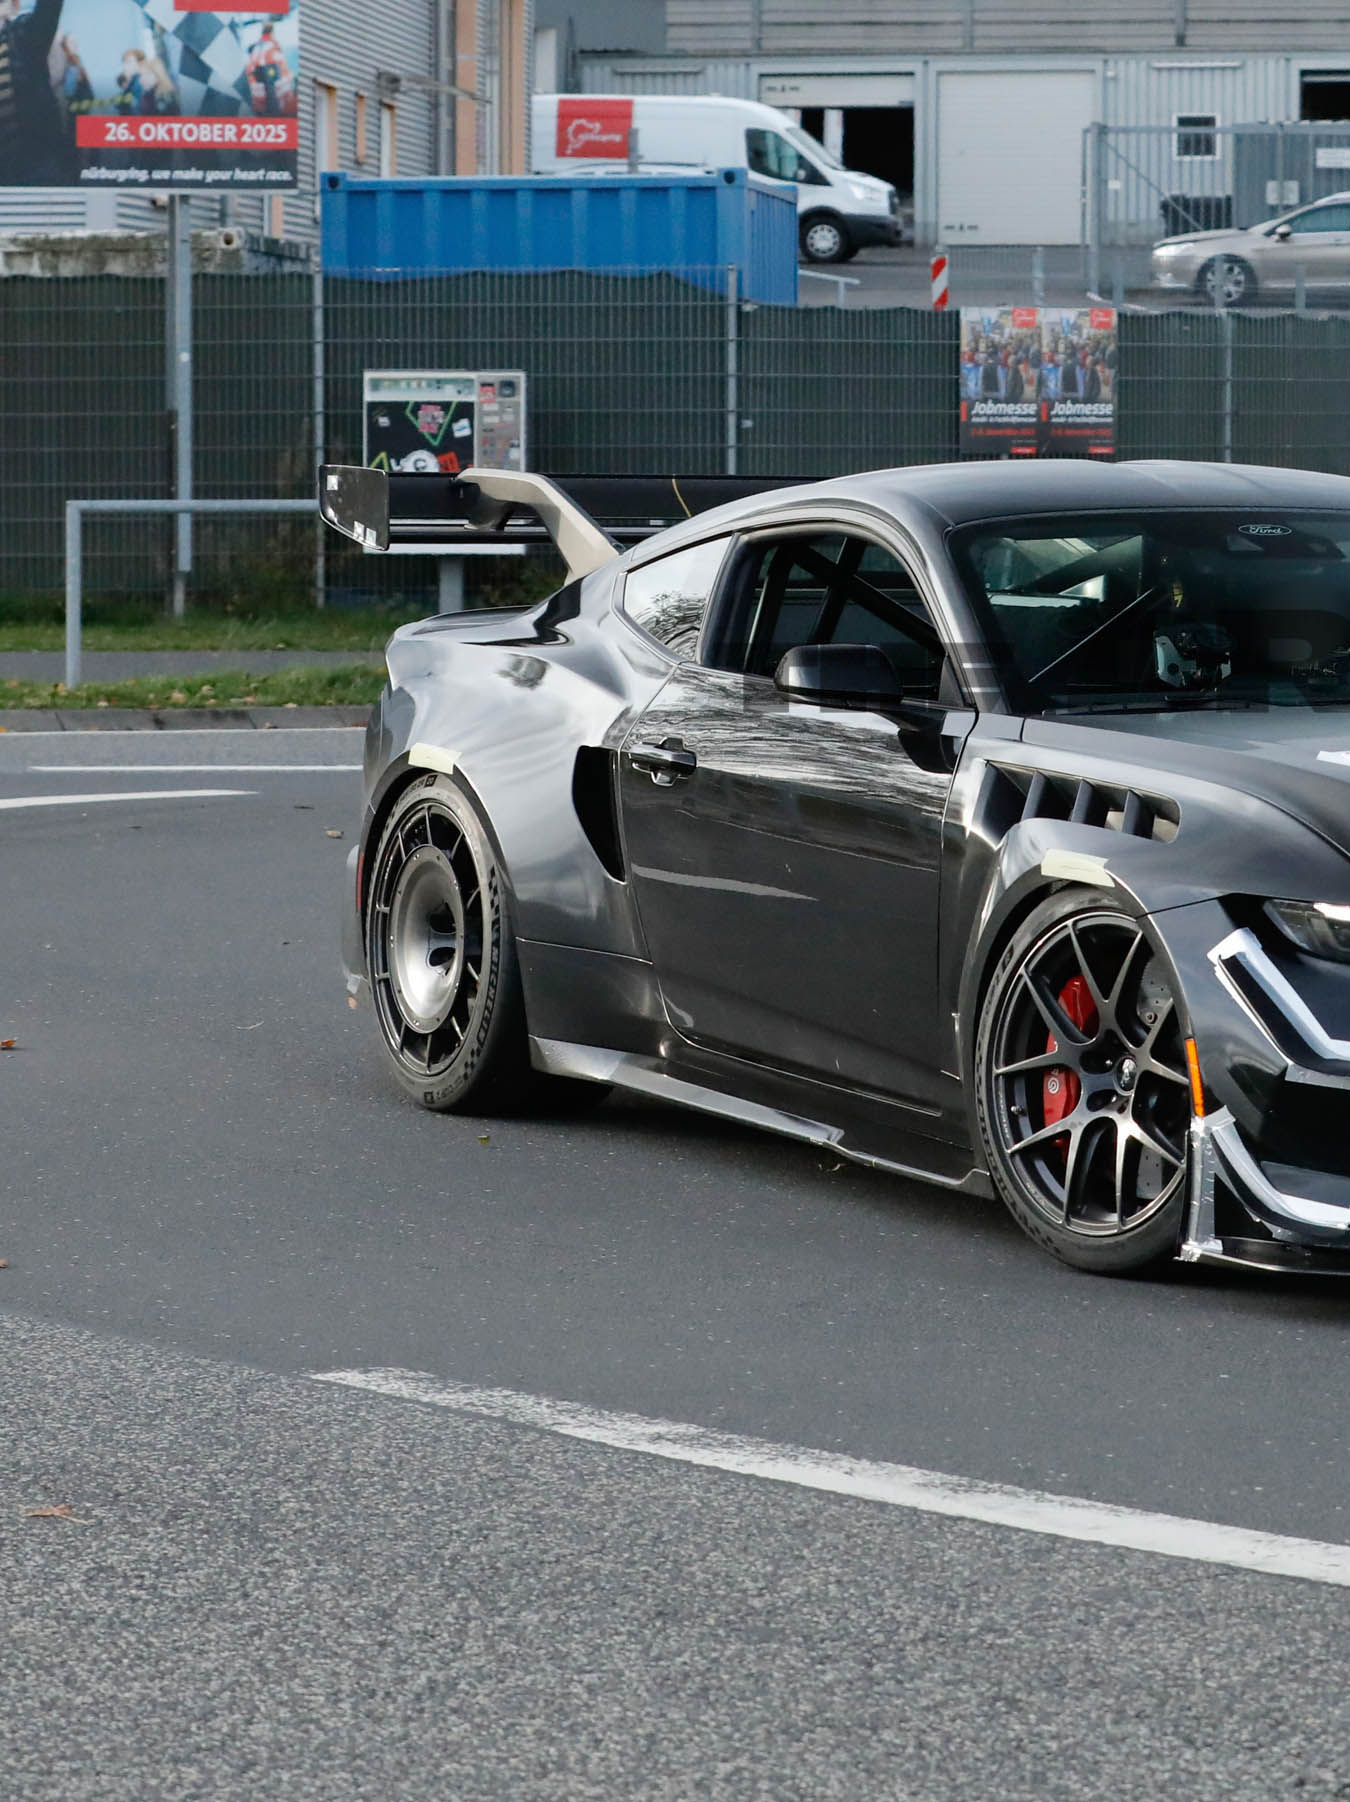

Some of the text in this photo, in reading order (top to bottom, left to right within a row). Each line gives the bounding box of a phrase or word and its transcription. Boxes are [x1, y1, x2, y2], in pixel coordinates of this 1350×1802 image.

[104, 122, 288, 143] 26. OKTOBER 2025
[204, 170, 233, 183] your
[233, 168, 265, 181] heart
[971, 399, 1038, 416] Jobmesse
[1050, 399, 1113, 416] Jobmesse
